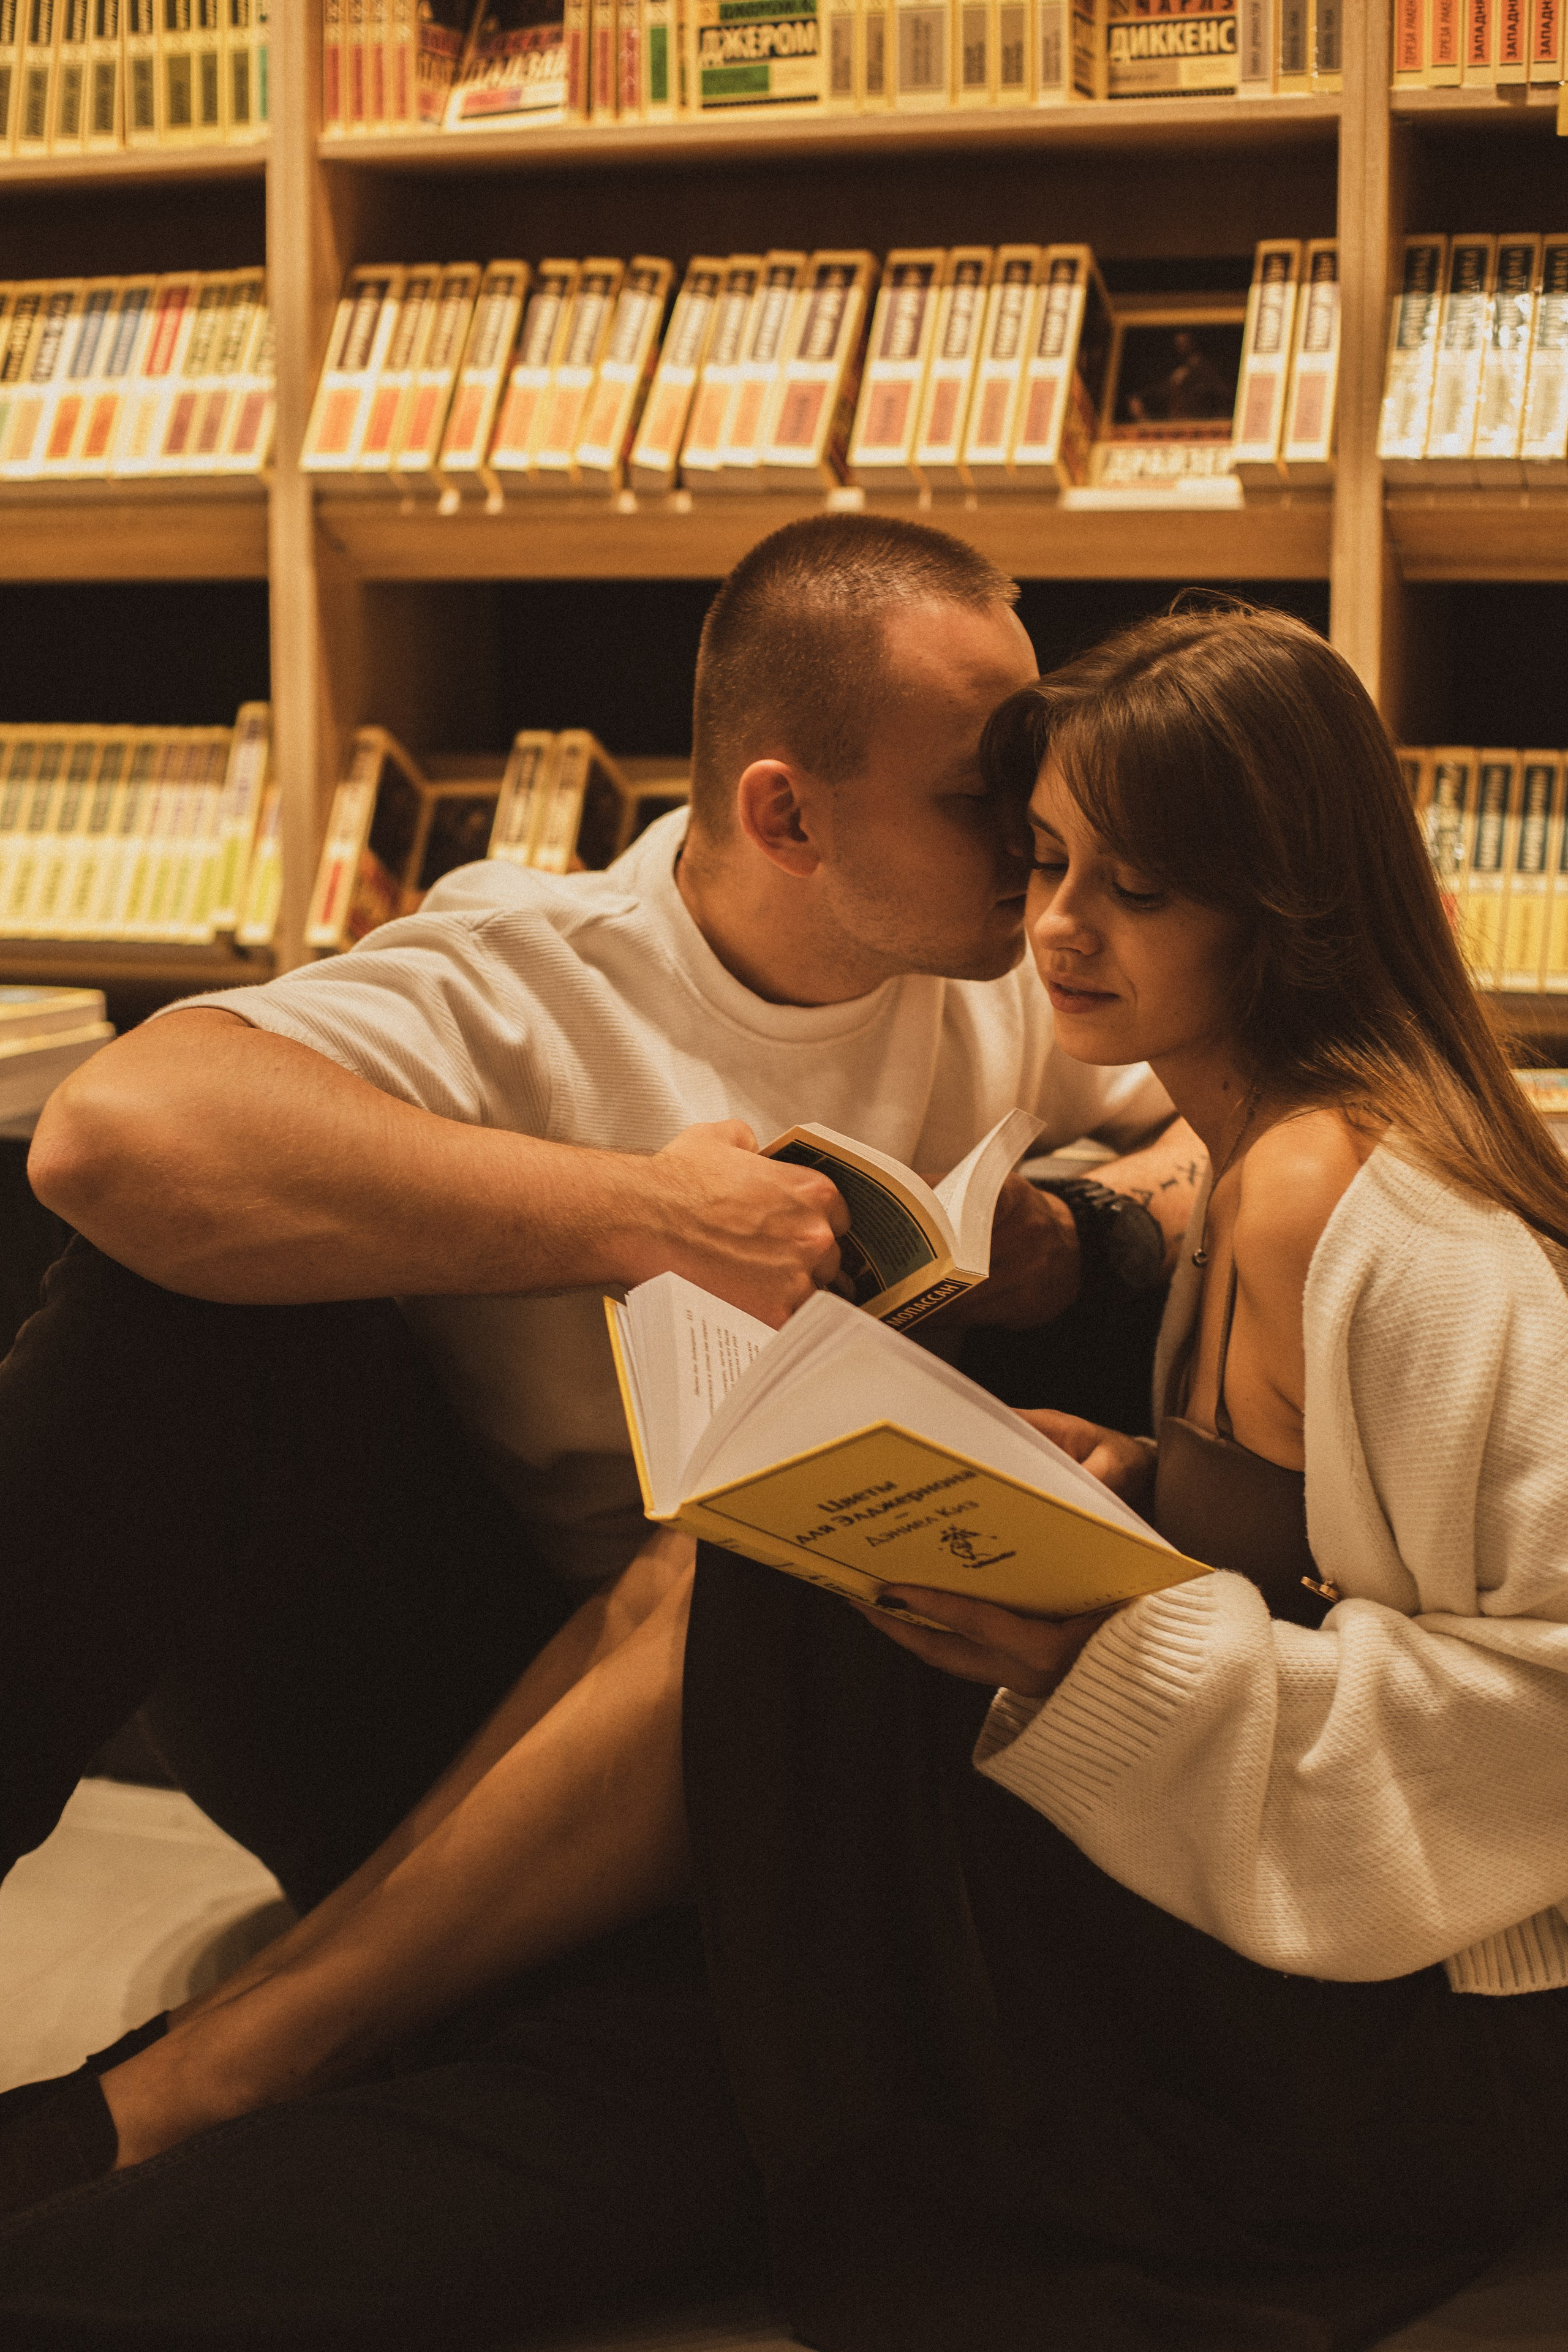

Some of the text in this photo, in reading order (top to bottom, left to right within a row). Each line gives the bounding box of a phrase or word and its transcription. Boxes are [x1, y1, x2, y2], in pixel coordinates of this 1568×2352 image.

[698, 21, 816, 67] ДЖЕРОМ
[1110, 19, 1235, 64] ДИККЕНС
[886, 1284, 960, 1326] МОПАССАН
[796, 1470, 977, 1545] для Элджернона
[817, 1480, 897, 1513] Цветы
[865, 1501, 980, 1548] Дэниел Киз
